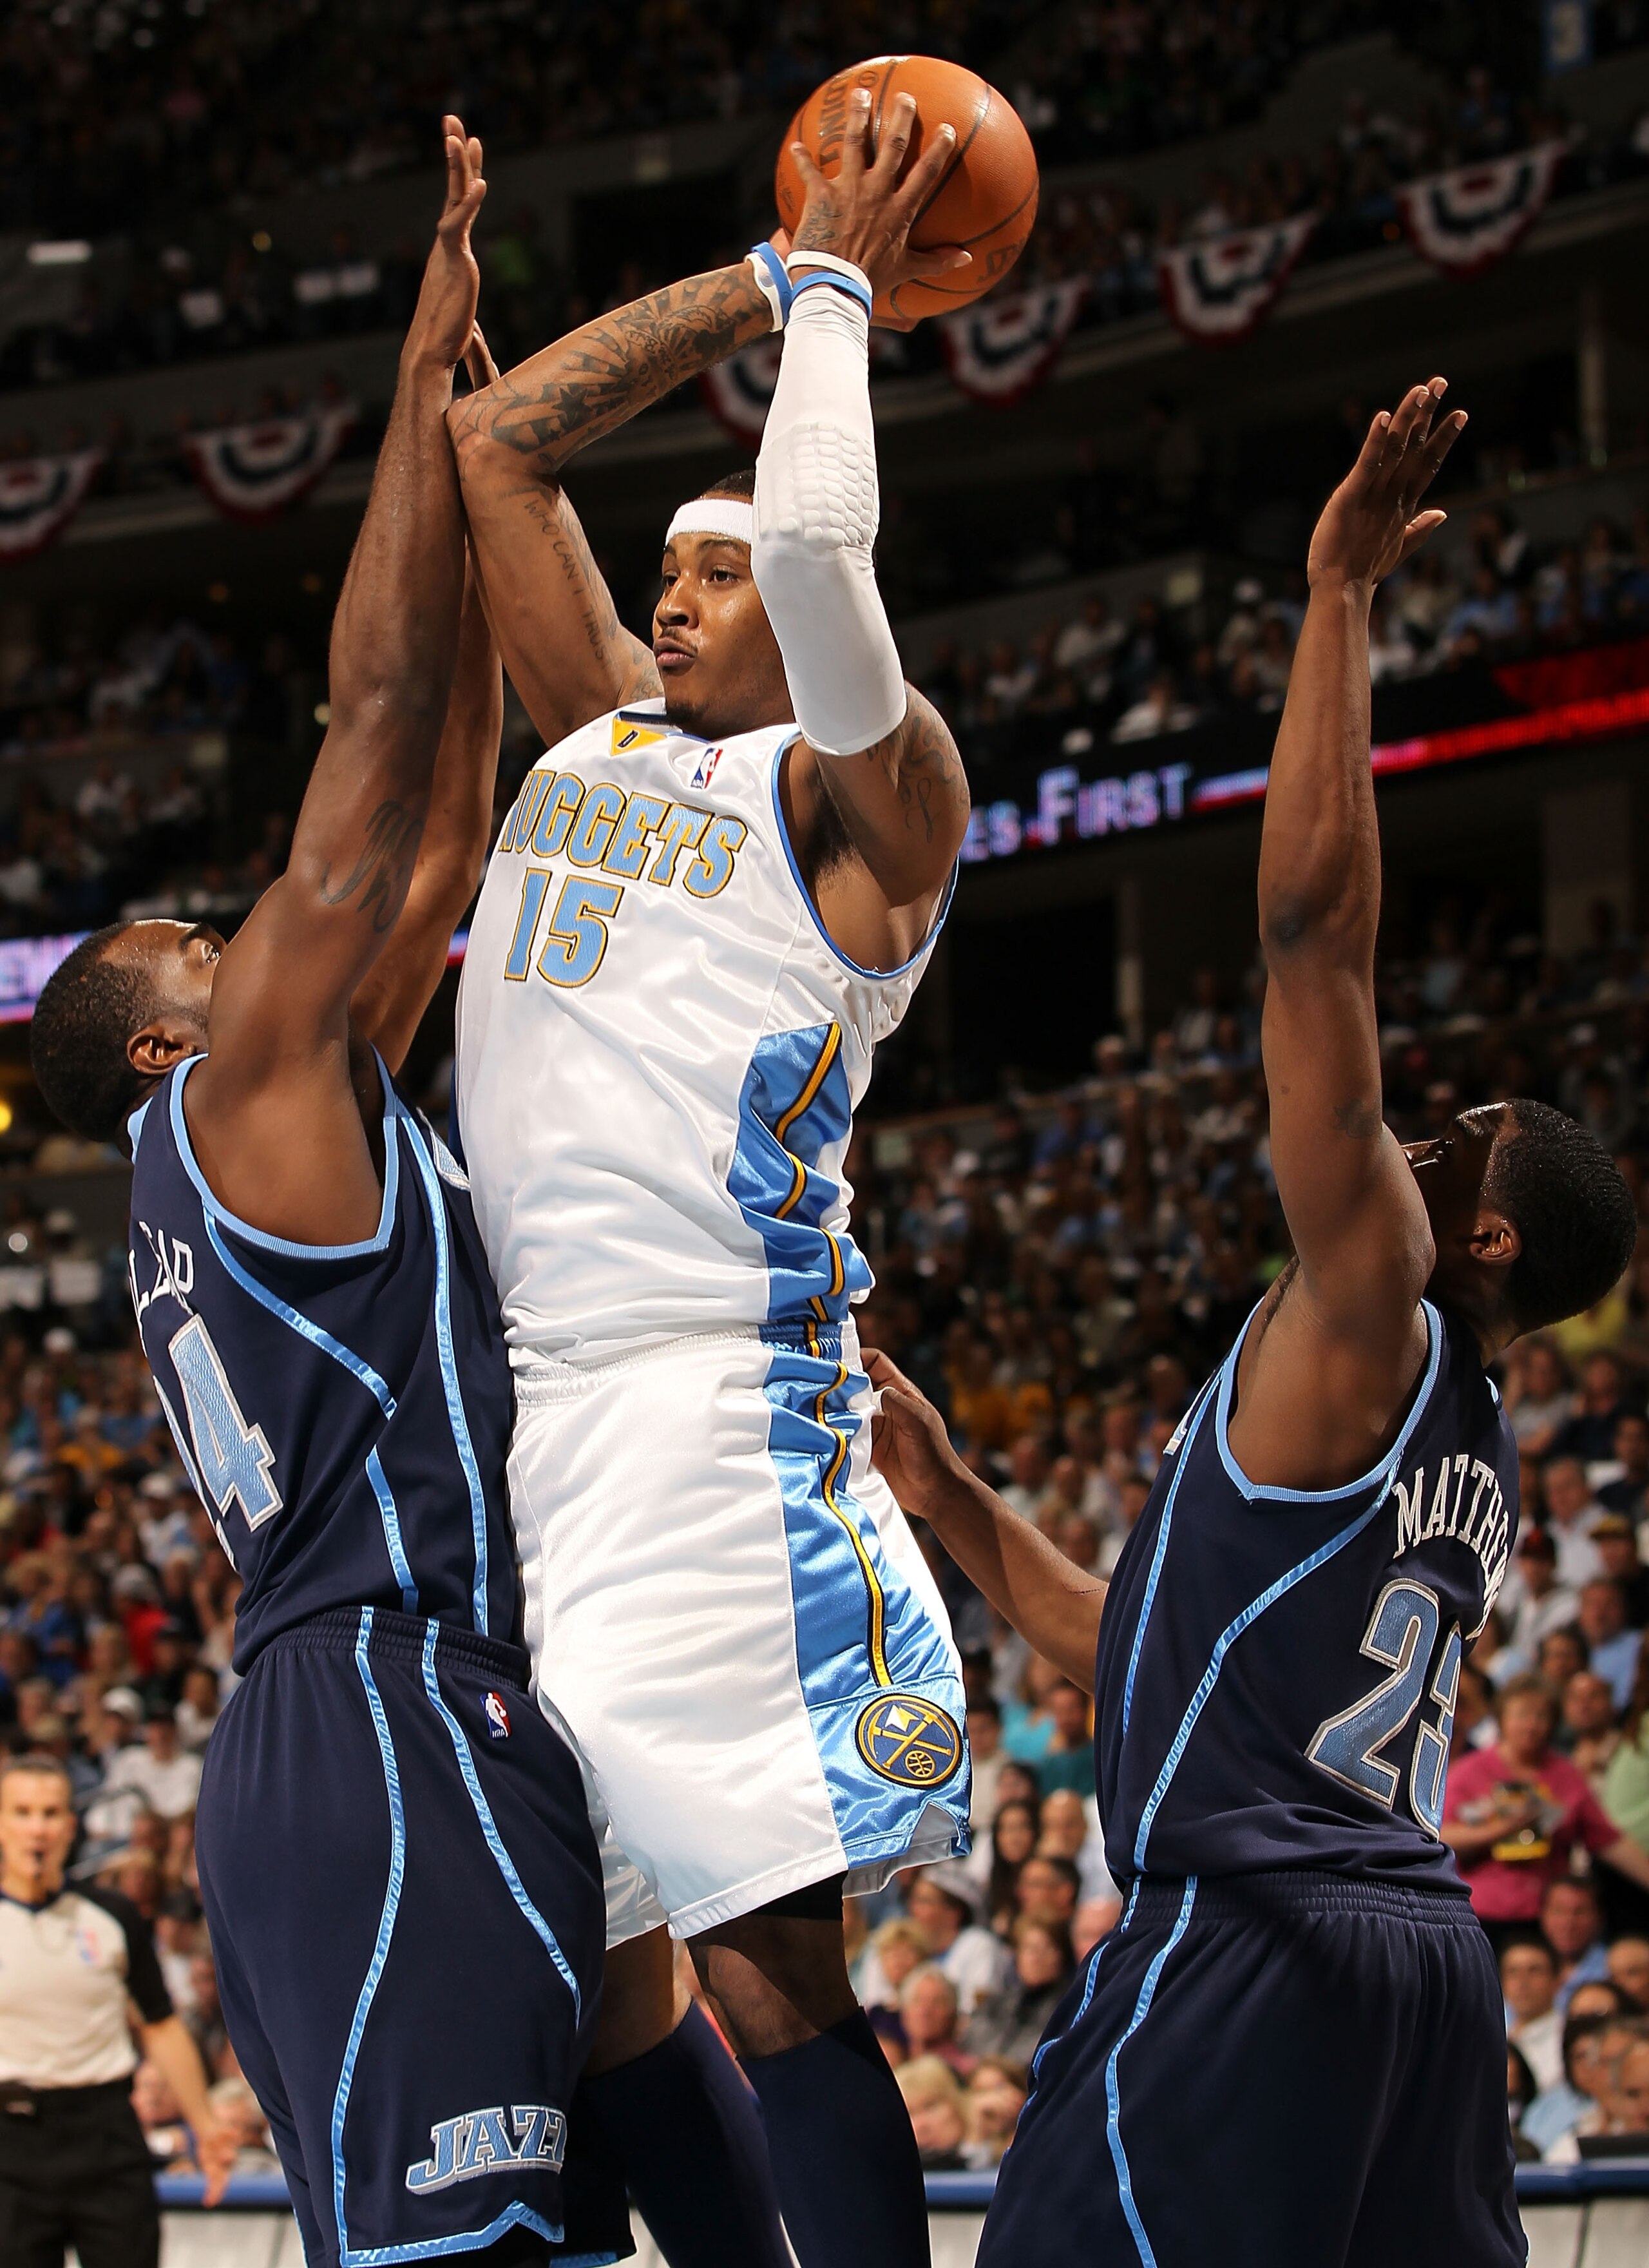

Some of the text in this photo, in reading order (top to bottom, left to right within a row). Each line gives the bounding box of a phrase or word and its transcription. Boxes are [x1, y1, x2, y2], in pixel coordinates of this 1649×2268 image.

[1036, 764, 1192, 847] FIRST
[504, 867, 625, 988] 15
[153, 1312, 283, 1573] 4
